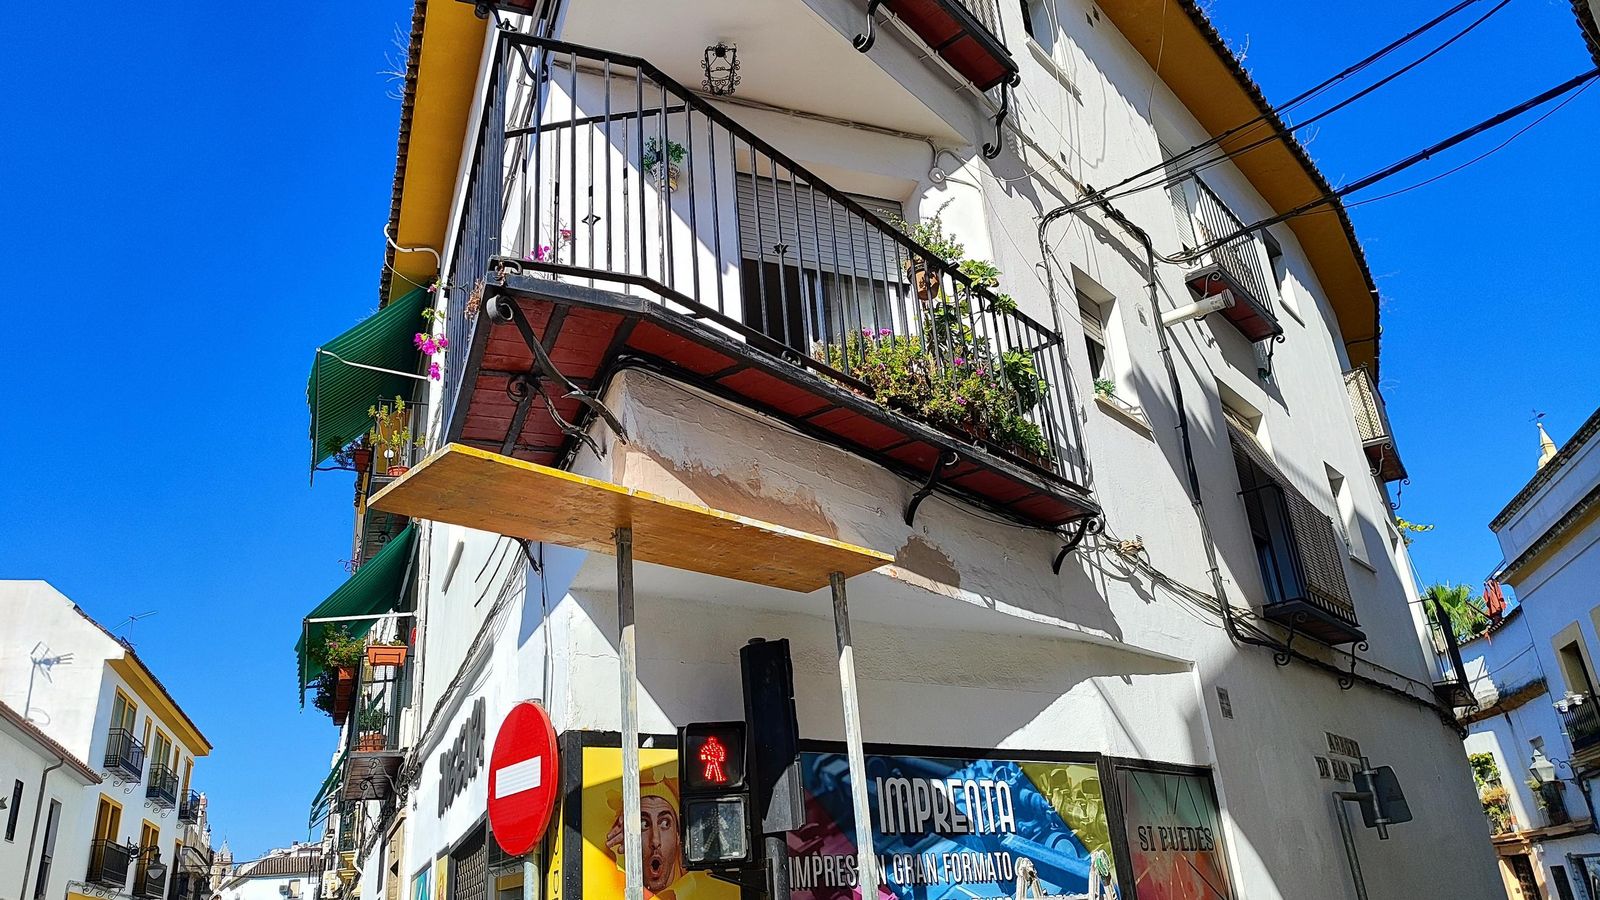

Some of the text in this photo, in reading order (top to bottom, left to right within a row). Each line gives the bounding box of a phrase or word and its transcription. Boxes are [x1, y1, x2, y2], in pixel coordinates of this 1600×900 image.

[875, 777, 1016, 833] IMPRENTA
[1158, 826, 1214, 851] PUEDES
[788, 852, 1013, 889] IMPRESN GRAN FORMATO
